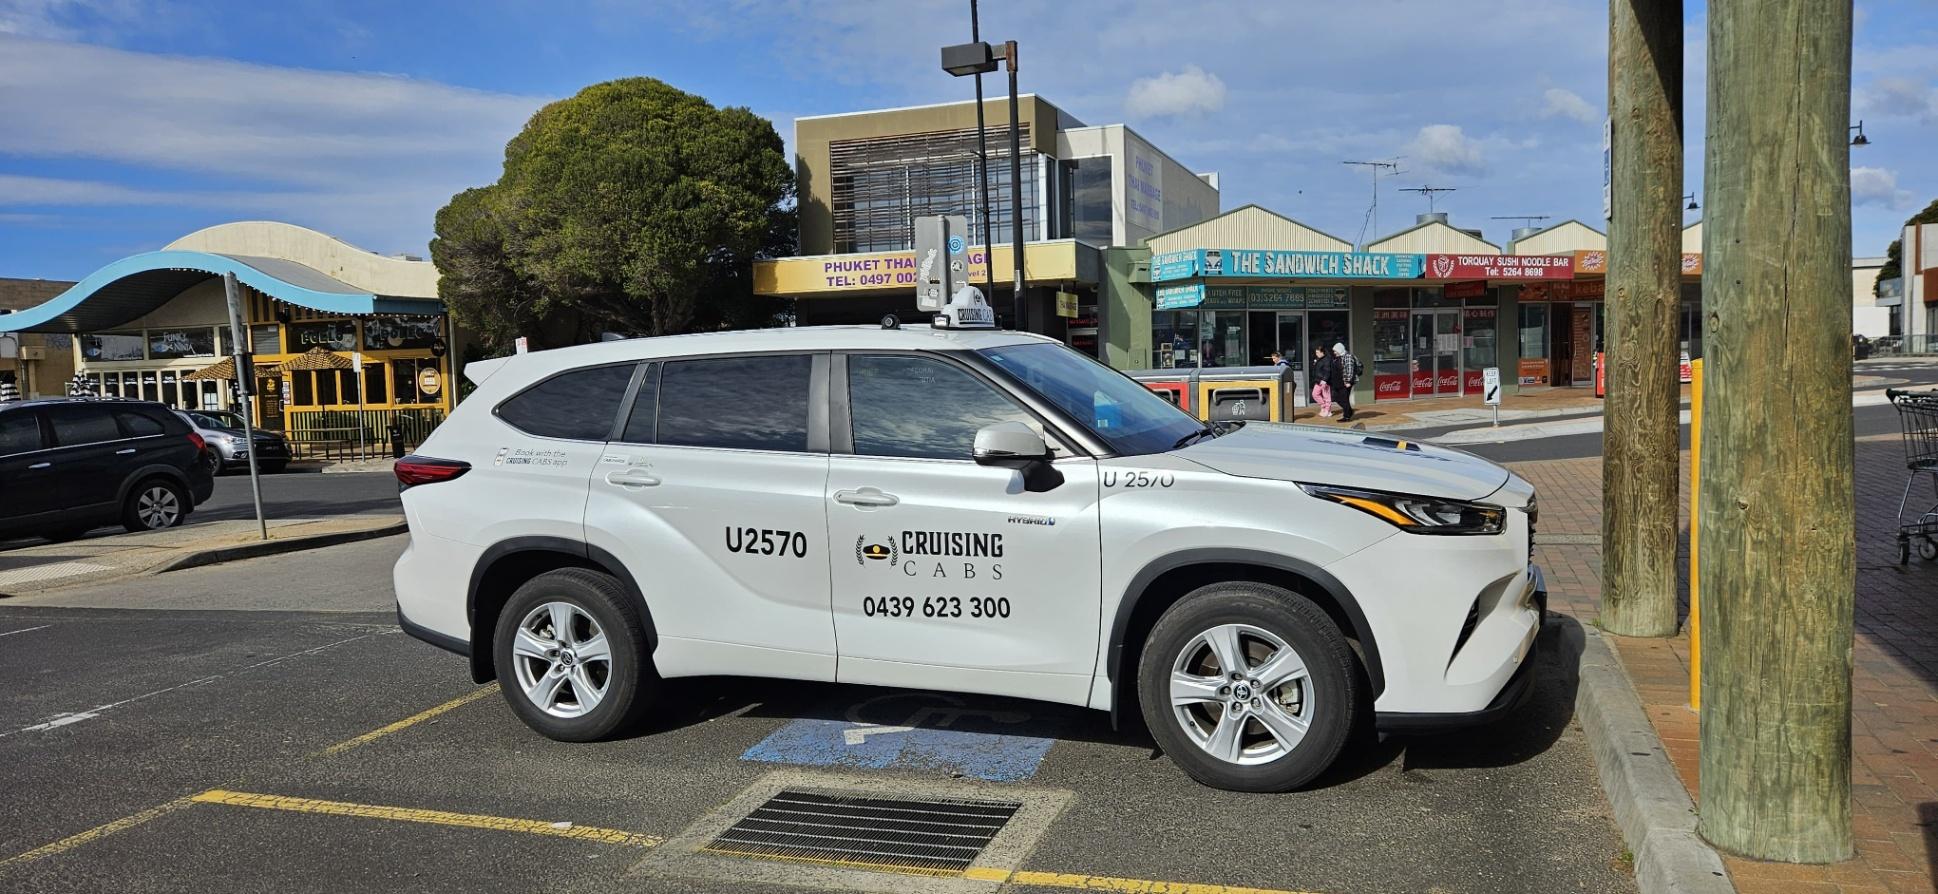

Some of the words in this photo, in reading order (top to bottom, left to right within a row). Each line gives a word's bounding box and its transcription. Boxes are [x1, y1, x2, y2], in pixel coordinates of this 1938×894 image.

[824, 259, 880, 273] PHUKET
[1231, 251, 1260, 274] THE
[1264, 252, 1339, 275] SANDWICH
[1342, 253, 1389, 276] SHACK
[1457, 256, 1494, 266] TORQUAY
[1497, 256, 1519, 266] SUSHI
[1521, 257, 1551, 267] NOODLE
[1553, 257, 1569, 267] BAR
[826, 275, 856, 287] TEL:
[860, 273, 892, 286] 0497
[1485, 266, 1499, 276] Tel:
[1503, 267, 1522, 276] 5264
[1524, 267, 1543, 277] 8698
[515, 448, 534, 457] Book
[1103, 471, 1117, 488] U
[725, 525, 808, 559] U2570
[901, 530, 1004, 558] CRUISING
[903, 560, 1003, 581] CABS
[863, 596, 915, 618] 0439
[922, 596, 962, 618] 623
[969, 596, 1011, 619] 300
